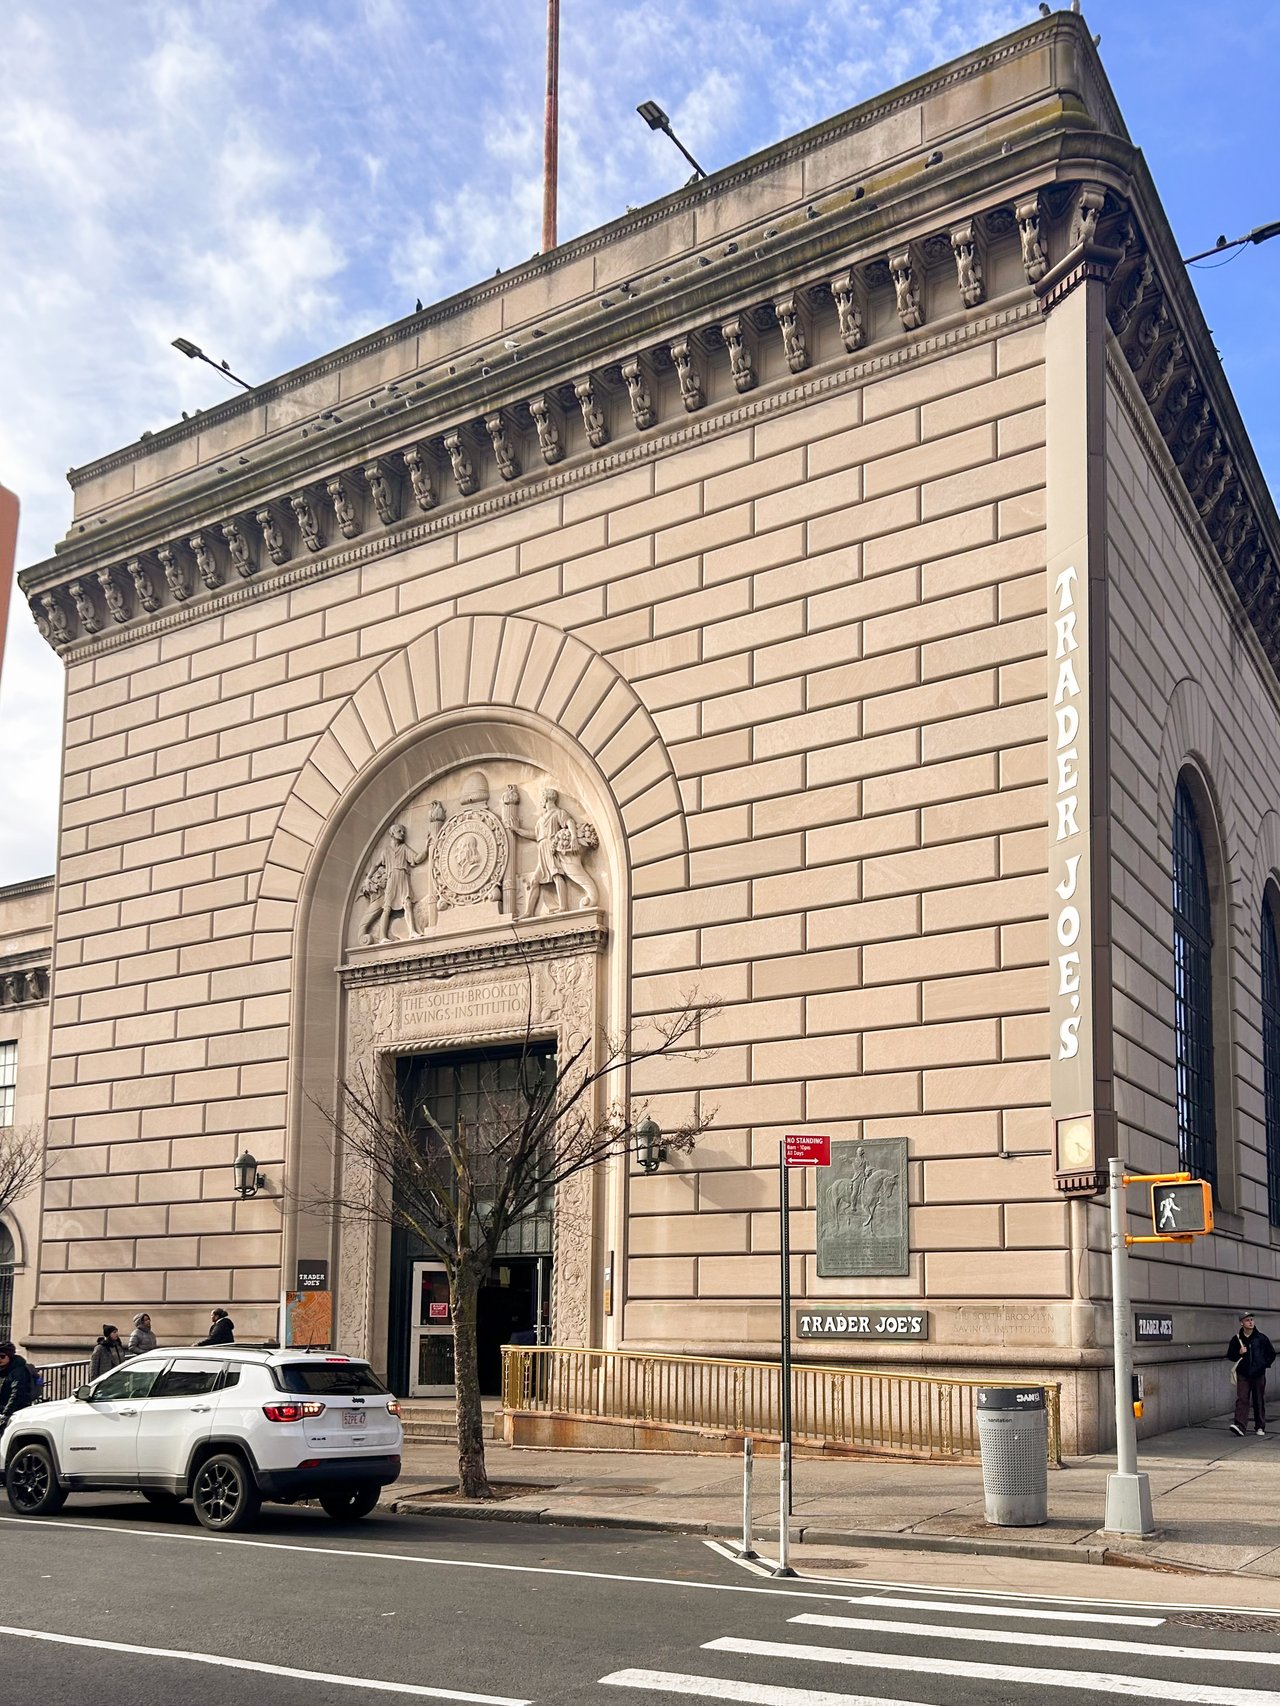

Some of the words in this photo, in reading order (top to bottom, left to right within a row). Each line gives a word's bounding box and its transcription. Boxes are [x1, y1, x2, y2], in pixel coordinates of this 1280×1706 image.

[1053, 565, 1081, 842] TRADER
[1055, 854, 1082, 1061] JOE'S
[404, 997, 424, 1010] THE
[427, 991, 464, 1009] SOUTH
[468, 983, 529, 1002] BROOKLYN
[404, 1008, 451, 1025] SAVINGS
[455, 998, 529, 1019] INSTITUTION
[800, 1316, 871, 1332] TRADER
[875, 1316, 923, 1333] JOE'S
[973, 1312, 1002, 1320] SOUTH
[1005, 1312, 1054, 1321] BROOKLYN
[1139, 1319, 1160, 1335] TRADER
[994, 1325, 1055, 1334] INSTITUTION
